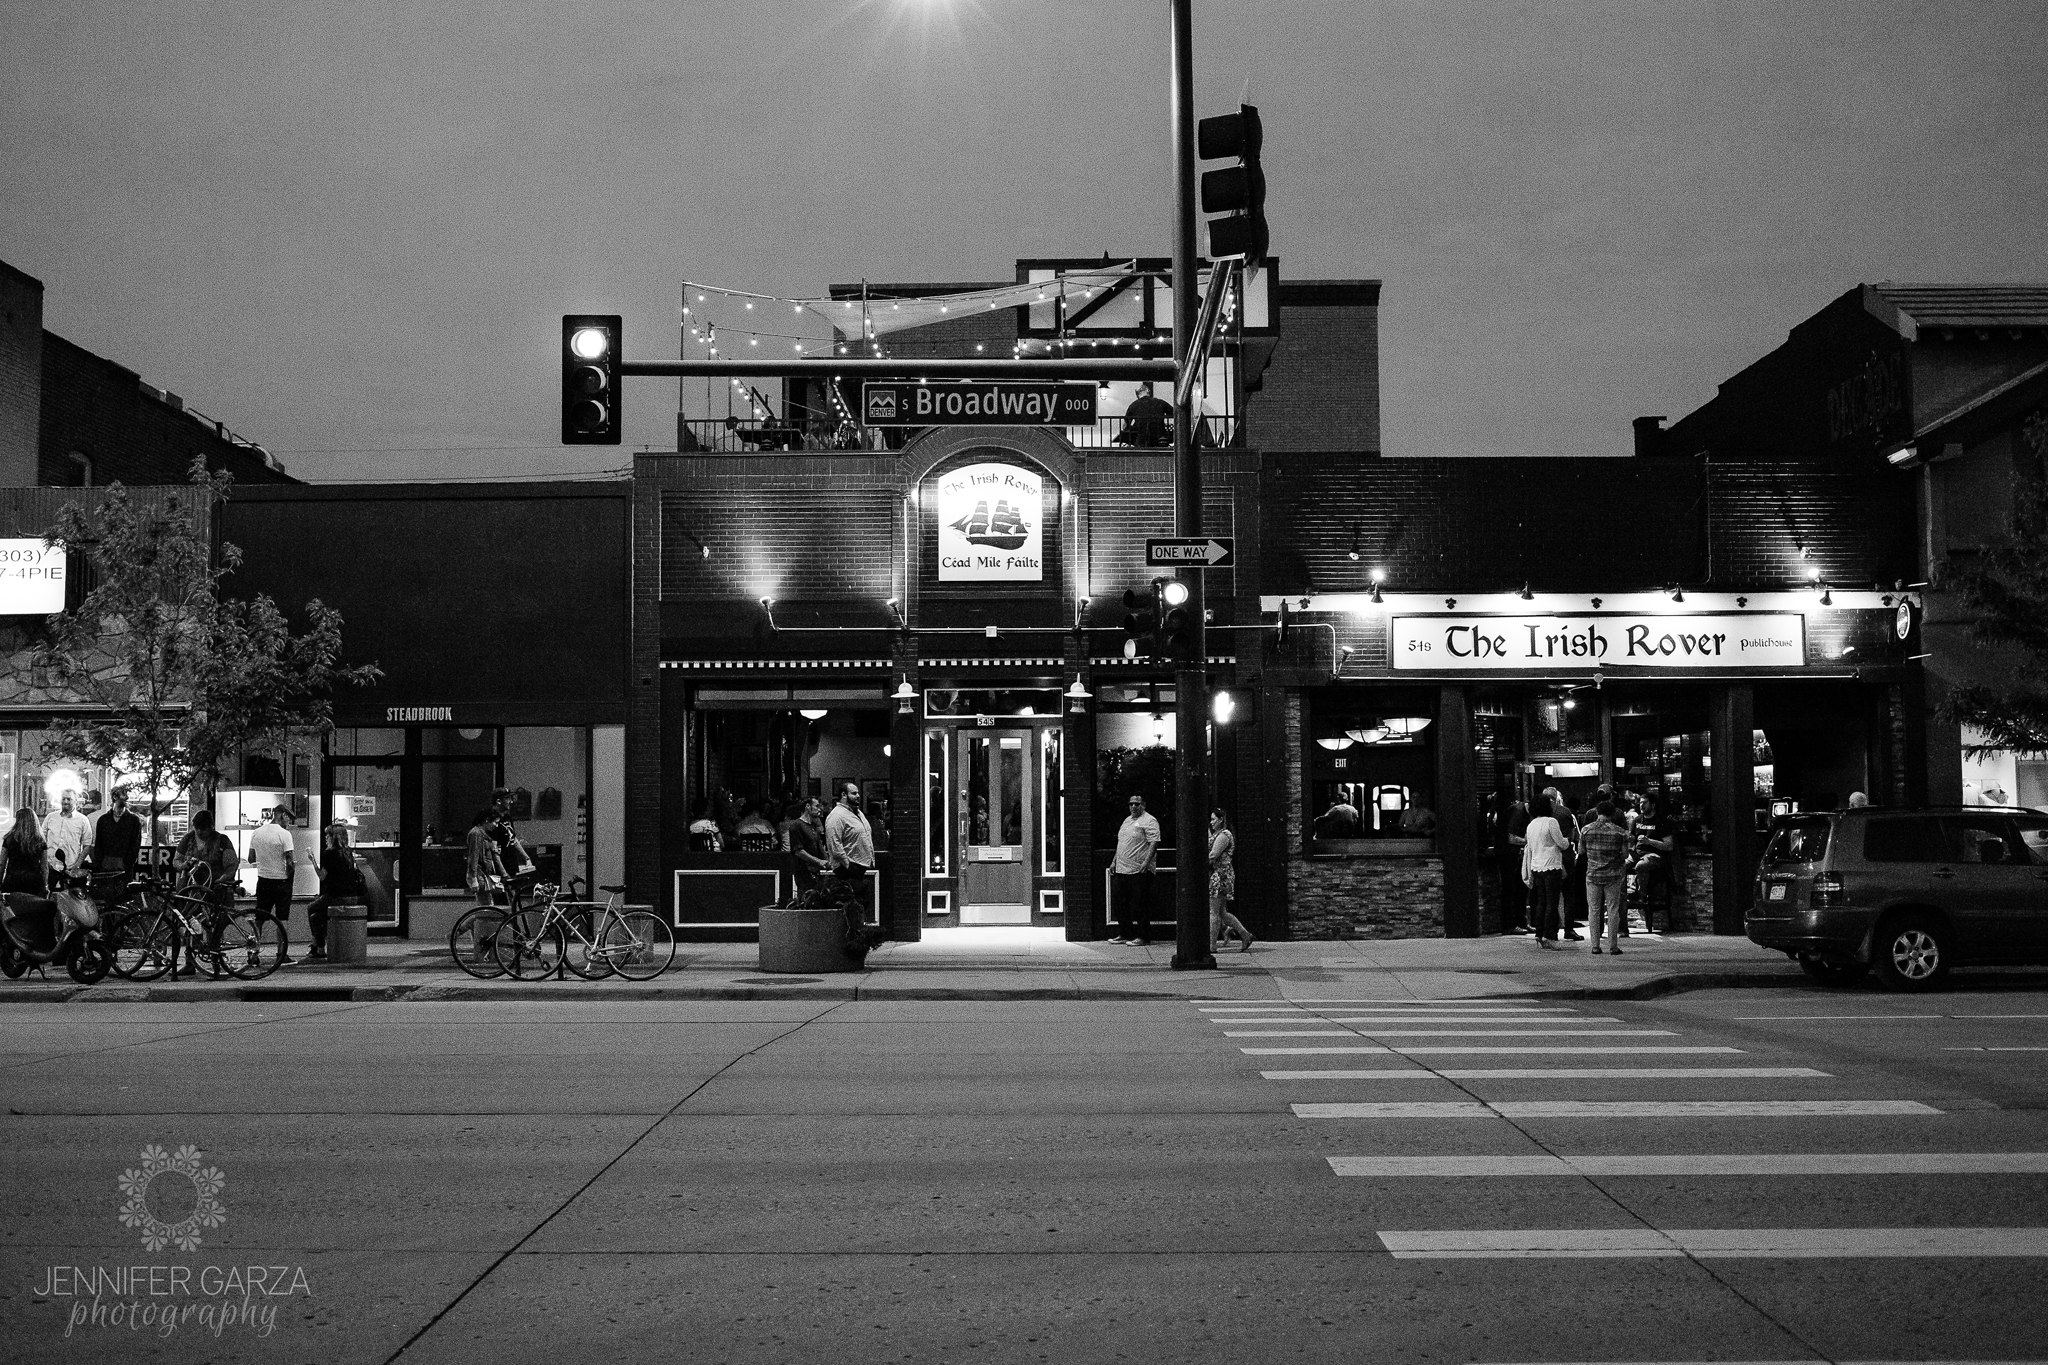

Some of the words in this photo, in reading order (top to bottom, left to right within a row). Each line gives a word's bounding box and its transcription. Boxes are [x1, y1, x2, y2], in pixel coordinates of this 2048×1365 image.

[916, 387, 1058, 422] Broadway
[870, 408, 896, 417] DENVER
[943, 481, 965, 496] The
[970, 472, 999, 486] Irish
[1004, 475, 1038, 496] Rover
[1155, 546, 1179, 558] ONE
[1182, 546, 1208, 558] WAY
[1445, 624, 1507, 658] The
[1523, 624, 1607, 658] Irish
[1626, 624, 1726, 658] Rover
[386, 706, 452, 721] STEADBROOK
[1335, 758, 1347, 768] EXIT
